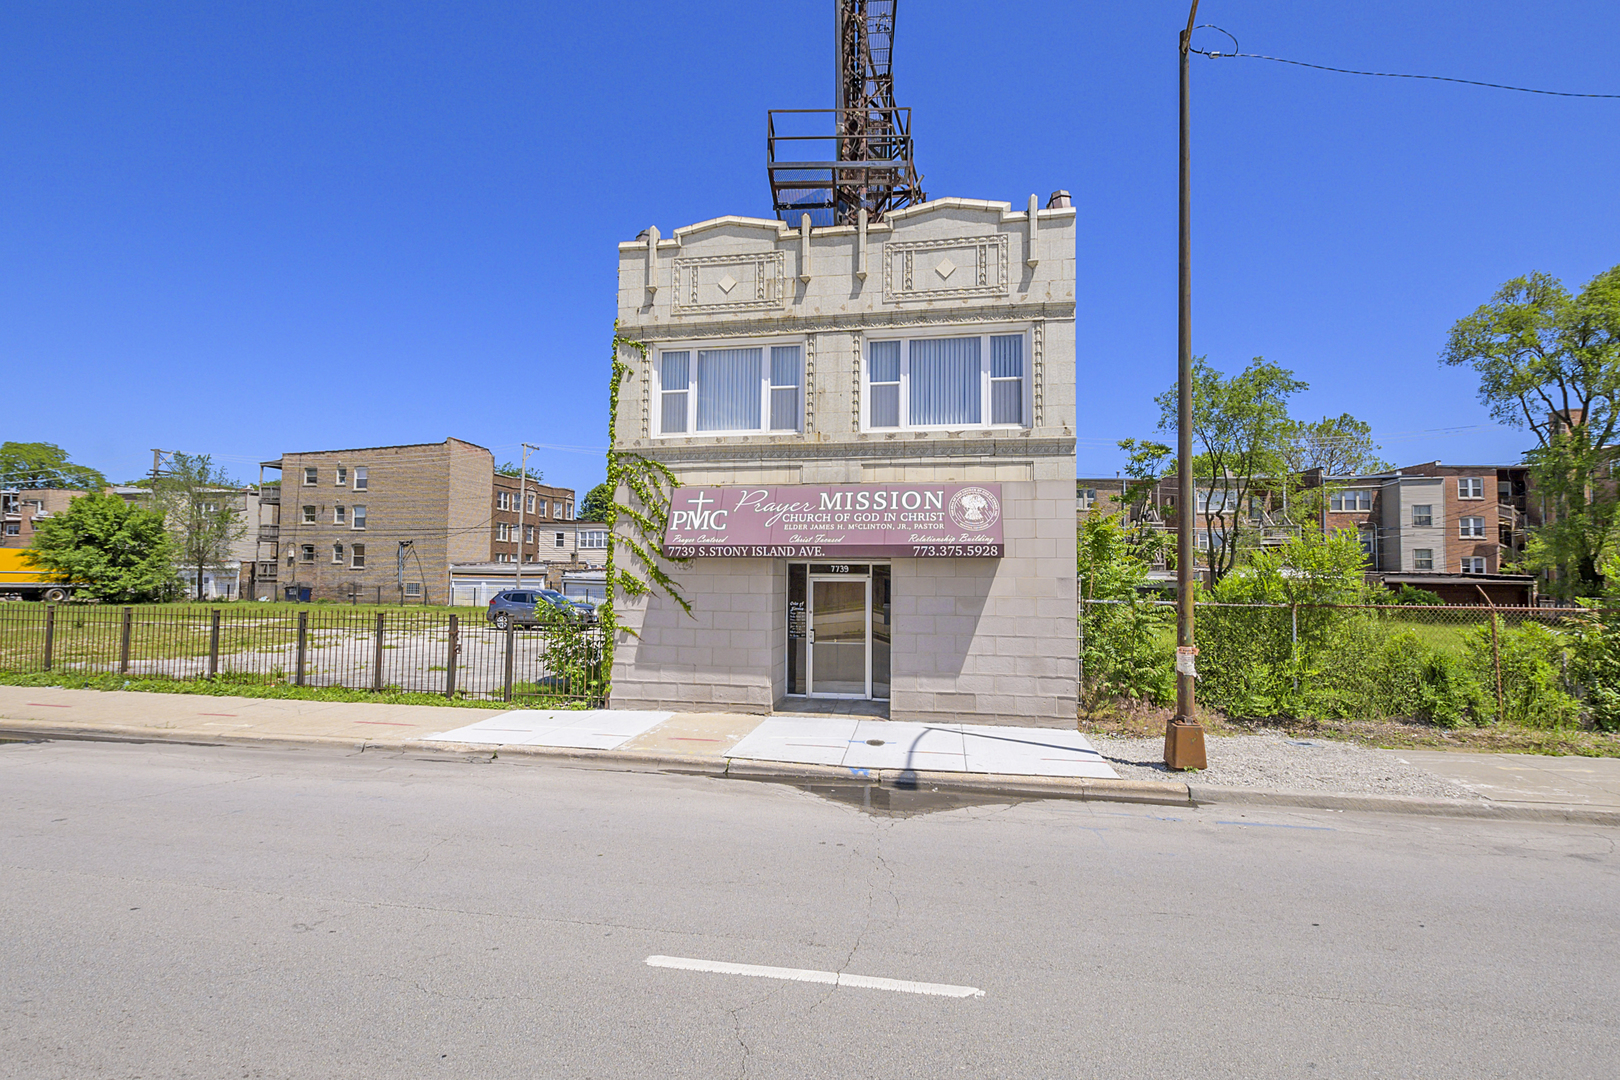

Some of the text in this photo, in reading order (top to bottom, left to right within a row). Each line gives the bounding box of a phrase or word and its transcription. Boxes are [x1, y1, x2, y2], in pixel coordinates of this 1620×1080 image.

[733, 489, 817, 528] Prayer
[818, 490, 944, 511] MISSION
[670, 510, 728, 530] PMC
[782, 512, 945, 522] CHURCH OF GOD IN CHRIST
[672, 534, 695, 545] Prayer
[788, 534, 846, 543] Christ Focused
[908, 533, 994, 545] Relationship Building
[668, 546, 695, 557] 7739
[752, 546, 795, 557] ISLAND
[798, 546, 825, 557] AVE.
[912, 545, 998, 557] 773.375.5928
[830, 565, 849, 573] 7739
